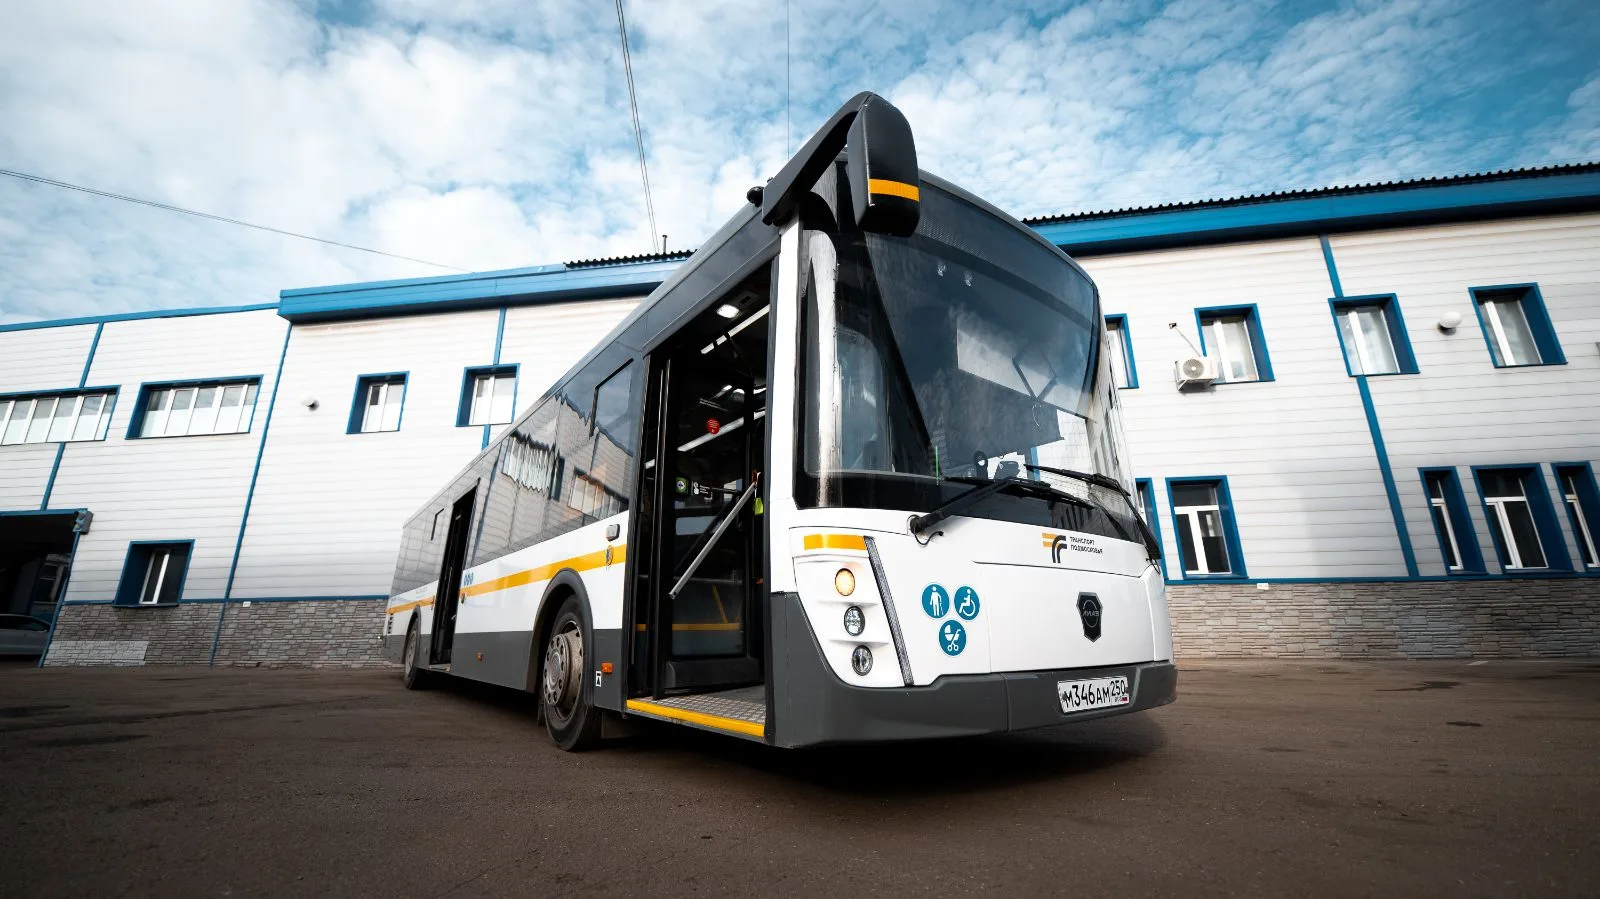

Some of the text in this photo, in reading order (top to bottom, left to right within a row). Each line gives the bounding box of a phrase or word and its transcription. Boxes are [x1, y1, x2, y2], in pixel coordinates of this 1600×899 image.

[1070, 536, 1095, 545] ТРАНСПОРТ
[1064, 680, 1126, 708] М346АМ 250
